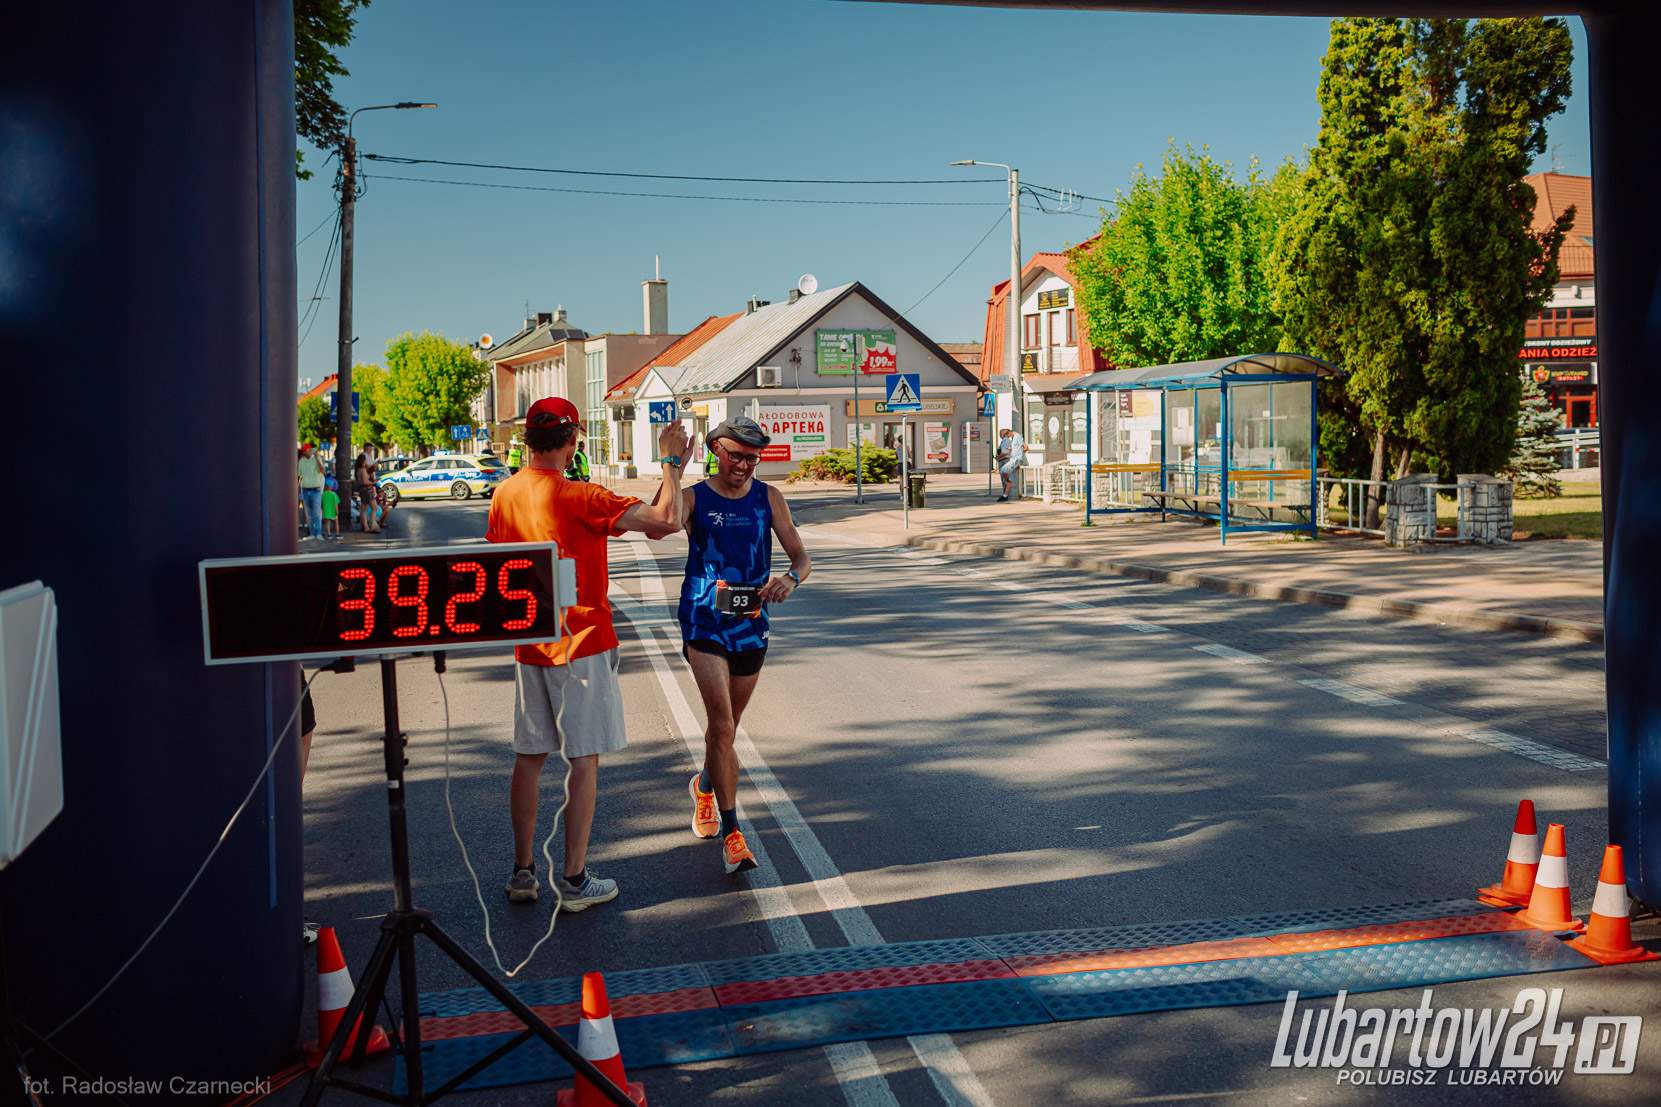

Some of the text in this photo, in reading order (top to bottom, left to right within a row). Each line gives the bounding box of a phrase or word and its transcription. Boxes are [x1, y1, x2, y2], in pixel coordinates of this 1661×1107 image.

[1519, 346, 1597, 358] ANIA ODZIEŻ
[758, 411, 824, 421] AŁODOBOWA
[772, 421, 824, 434] APTEKA
[338, 558, 538, 641] 39.25
[732, 595, 749, 607] 93
